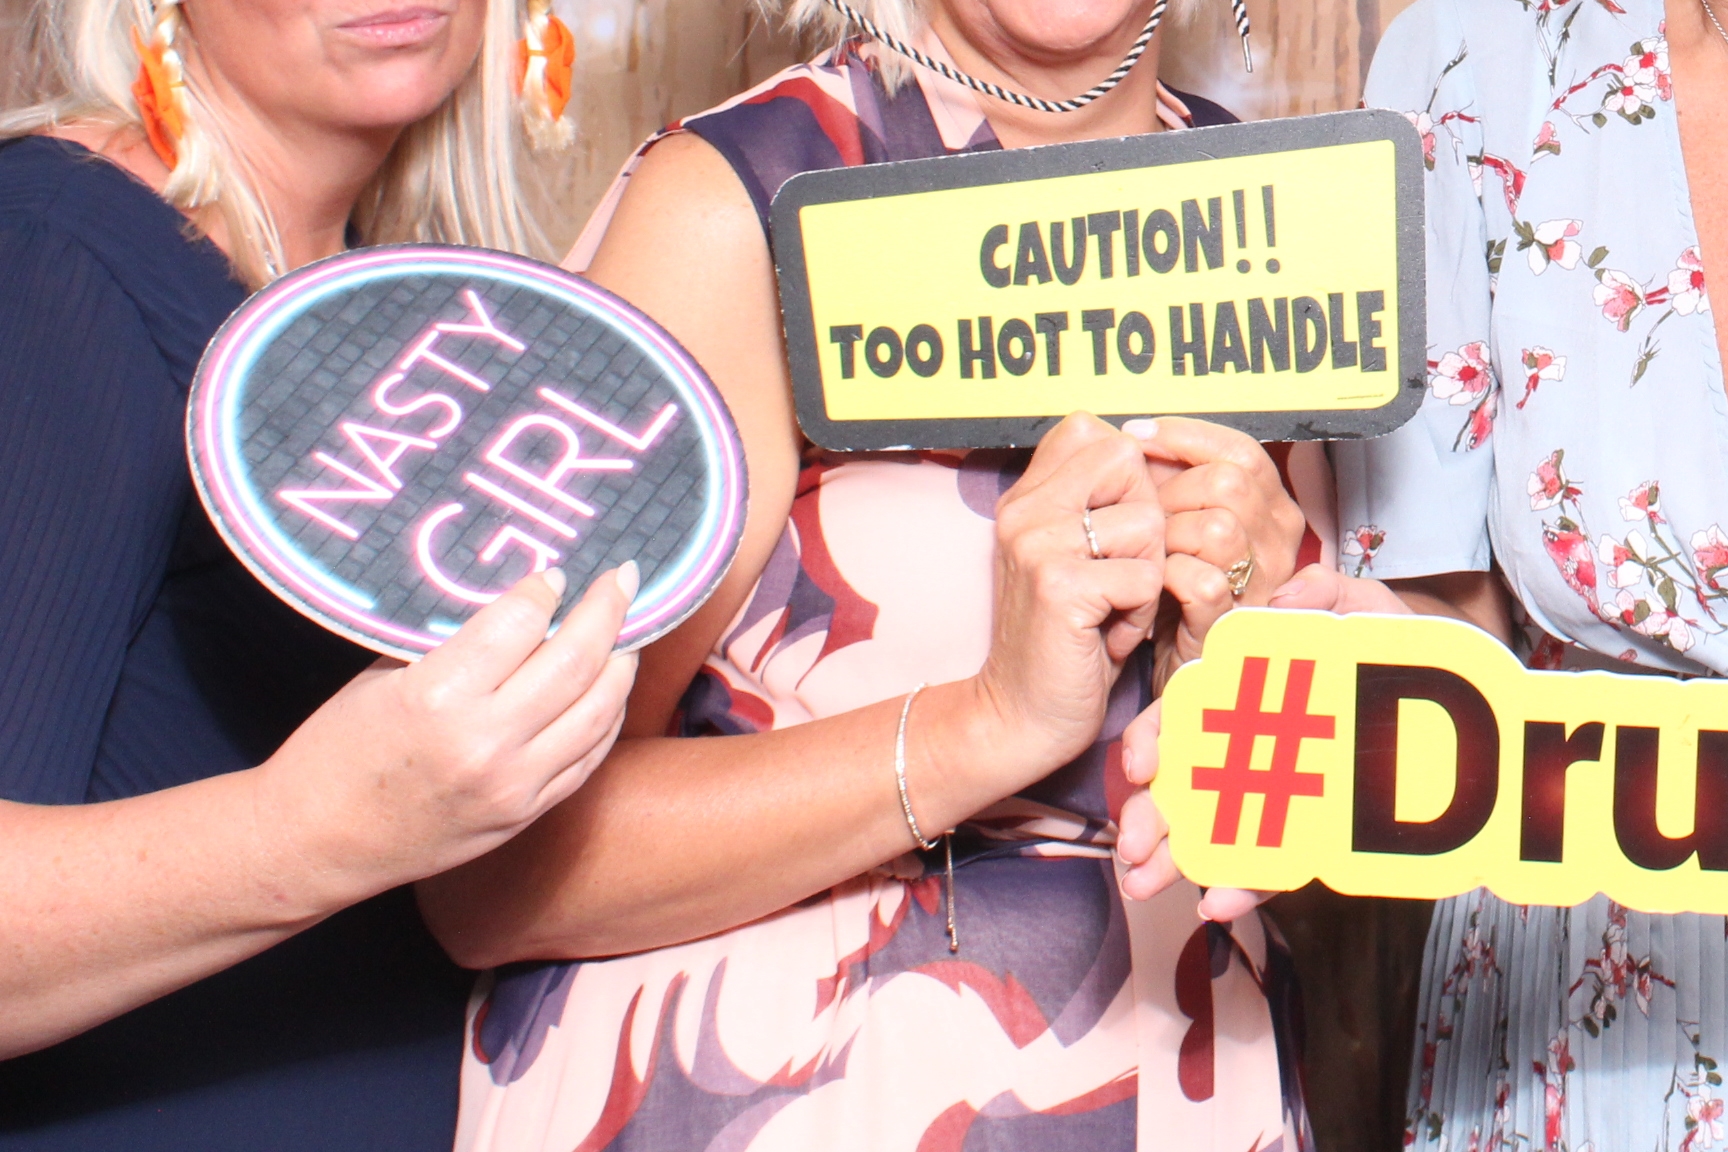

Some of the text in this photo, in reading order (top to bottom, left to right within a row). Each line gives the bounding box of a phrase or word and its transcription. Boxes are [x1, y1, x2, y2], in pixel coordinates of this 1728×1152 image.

[980, 185, 1281, 289] CAUTION!!
[276, 289, 527, 541] NASTY
[829, 290, 1387, 380] TOO HOT TO HANDLE
[416, 386, 679, 605] GIRL
